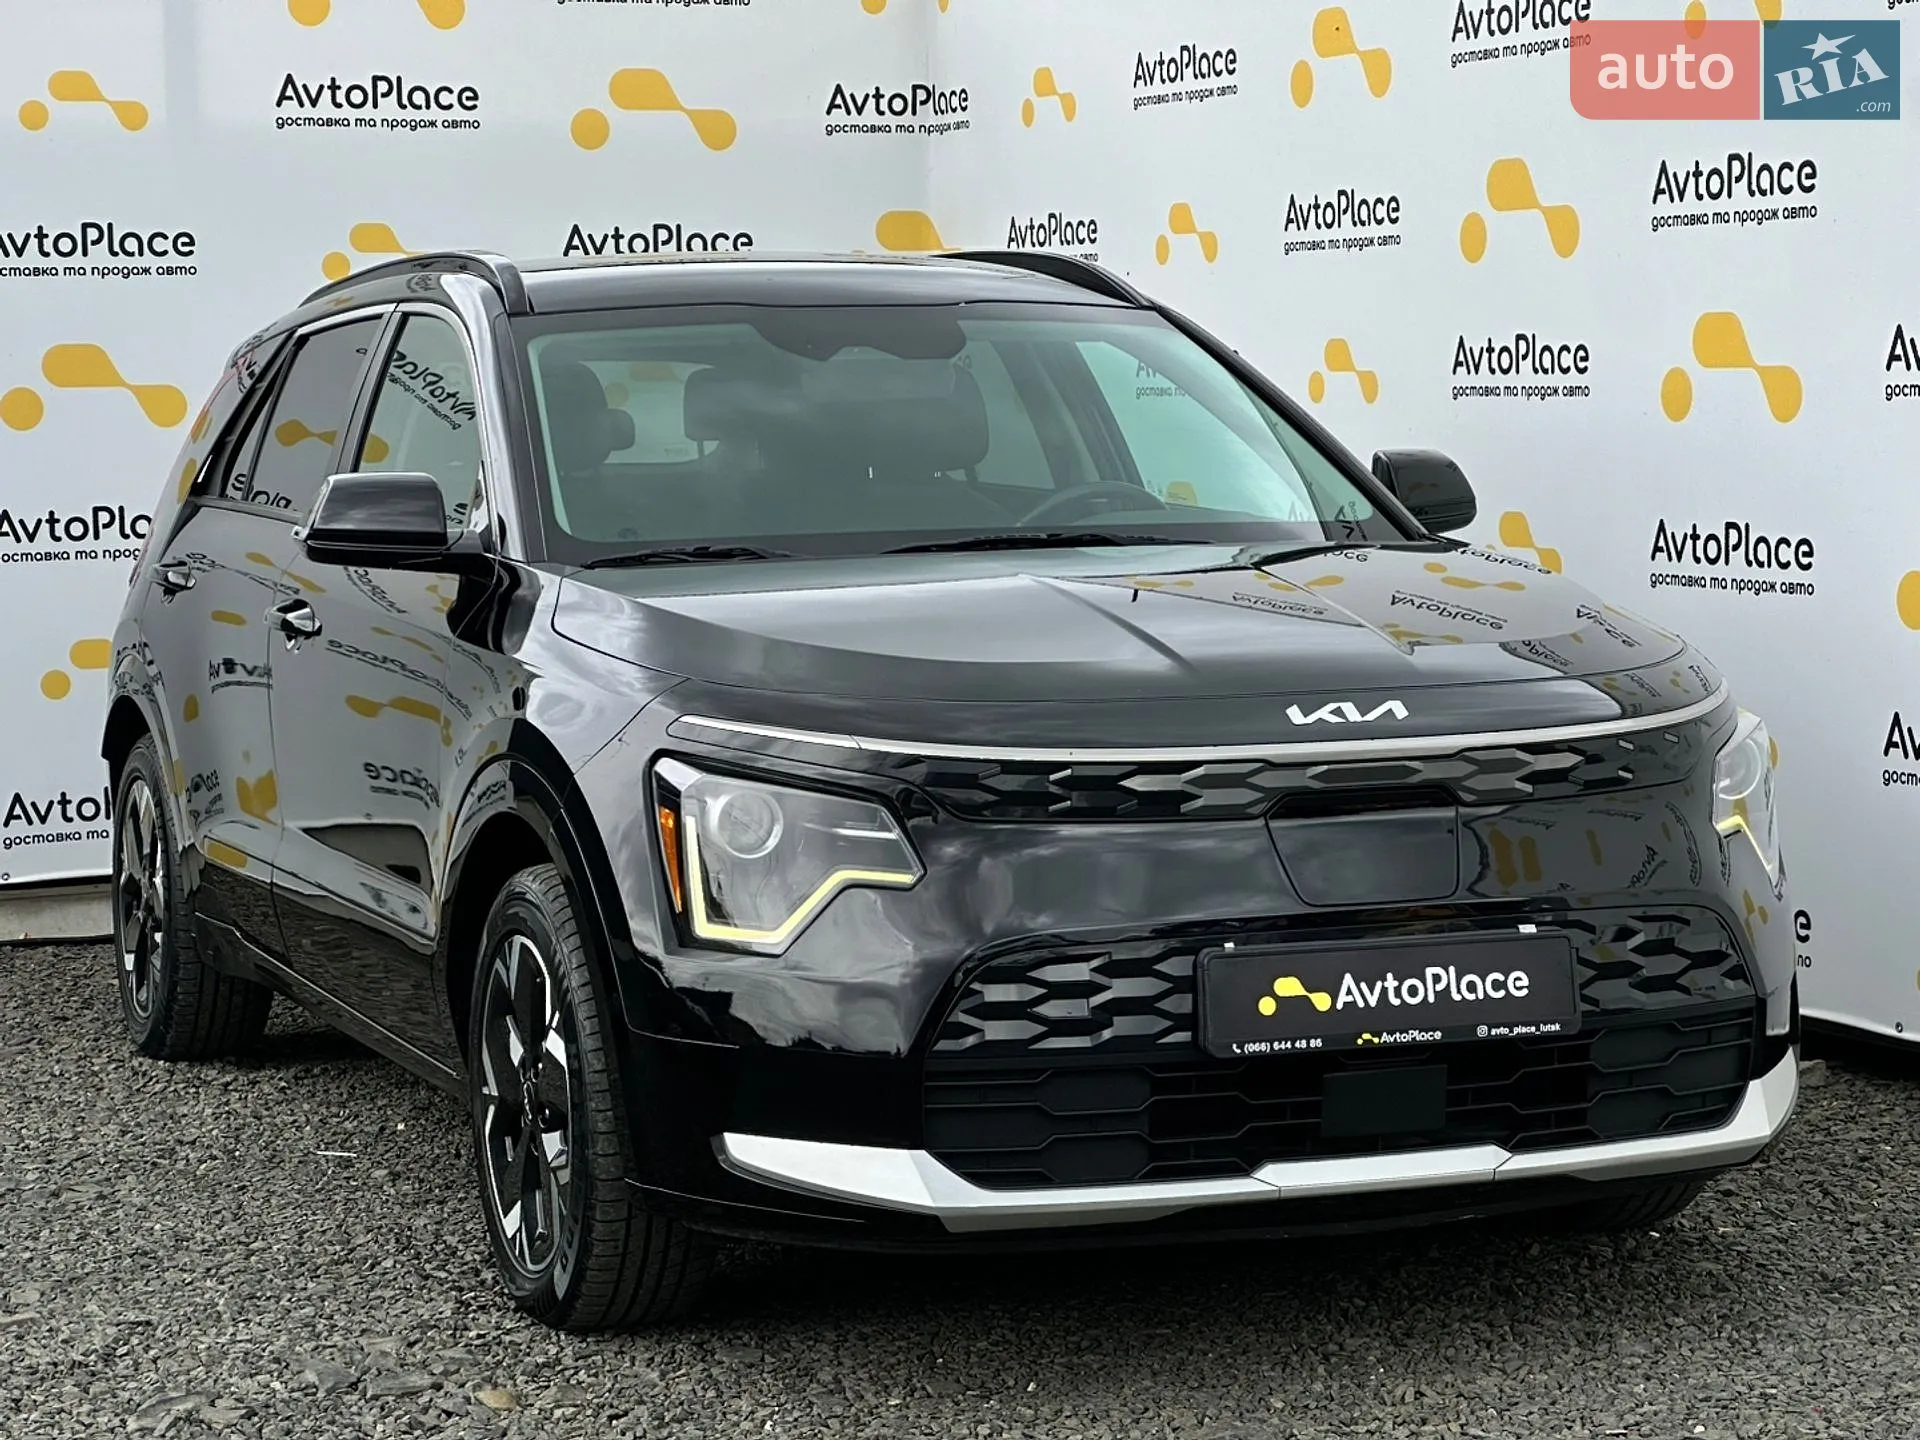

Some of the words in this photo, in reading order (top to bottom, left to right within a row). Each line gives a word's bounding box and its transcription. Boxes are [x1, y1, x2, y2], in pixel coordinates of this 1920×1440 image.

[1452, 0, 1592, 42] AvtoPlace
[1133, 43, 1237, 89] AvtoPlace
[1451, 47, 1500, 68] доставка
[1502, 45, 1517, 58] та
[1520, 39, 1560, 58] продаж
[275, 73, 480, 111] AvtoPlace
[825, 83, 969, 117] AvtoPlace
[275, 117, 351, 130] доставка
[355, 117, 377, 128] та
[381, 118, 438, 131] продаж
[442, 119, 481, 130] авто
[1652, 151, 1817, 205] AvtoPlace
[1284, 188, 1400, 232] AvtoPlace
[1651, 213, 1709, 232] доставка
[1712, 211, 1730, 225] та
[1733, 208, 1779, 227] продаж
[1783, 205, 1817, 220] авто
[563, 223, 754, 257] AvtoPlace
[1007, 212, 1097, 249] AvtoPlace
[64, 266, 87, 277] та
[92, 265, 152, 279] продаж
[156, 266, 198, 276] авто
[1452, 333, 1589, 376] AvtoPlace
[1452, 385, 1501, 401] доставка
[1503, 386, 1518, 397] та
[1521, 385, 1560, 401] продаж
[1562, 385, 1591, 397] авто
[75, 550, 98, 560] та
[1651, 518, 1815, 572] AvtoPlace
[1650, 572, 1707, 589] доставка
[1709, 576, 1727, 590] та
[1730, 578, 1778, 597] продаж
[1780, 581, 1815, 597] авто
[3, 831, 82, 850] доставка
[87, 829, 109, 840] та
[1336, 965, 1530, 1010] AvtoPlace
[1380, 1029, 1442, 1044] AvtoPlace
